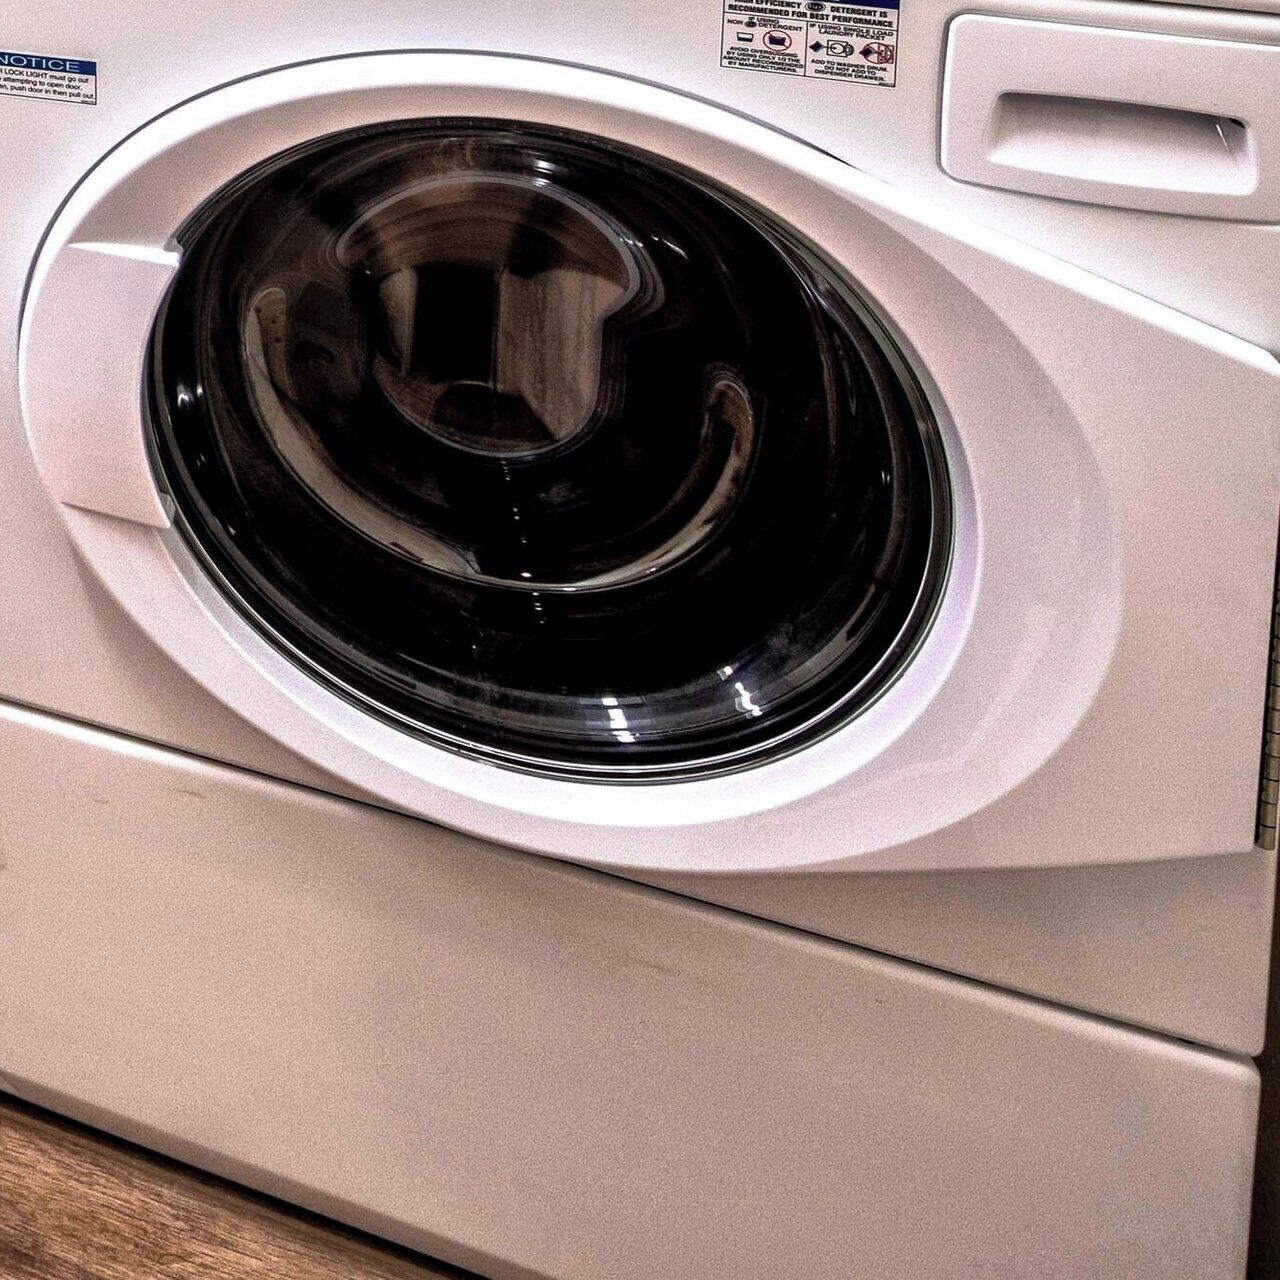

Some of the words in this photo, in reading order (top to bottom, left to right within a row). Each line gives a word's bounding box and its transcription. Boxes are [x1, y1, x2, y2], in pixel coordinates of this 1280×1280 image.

[728, 4, 789, 17] RECOMMENDED
[810, 13, 830, 21] BEST
[832, 14, 893, 28] PERFORMANCE
[830, 6, 877, 17] DETERGENT
[880, 10, 888, 18] IS
[26, 71, 48, 79] LIGHT
[3, 76, 37, 86] attempting
